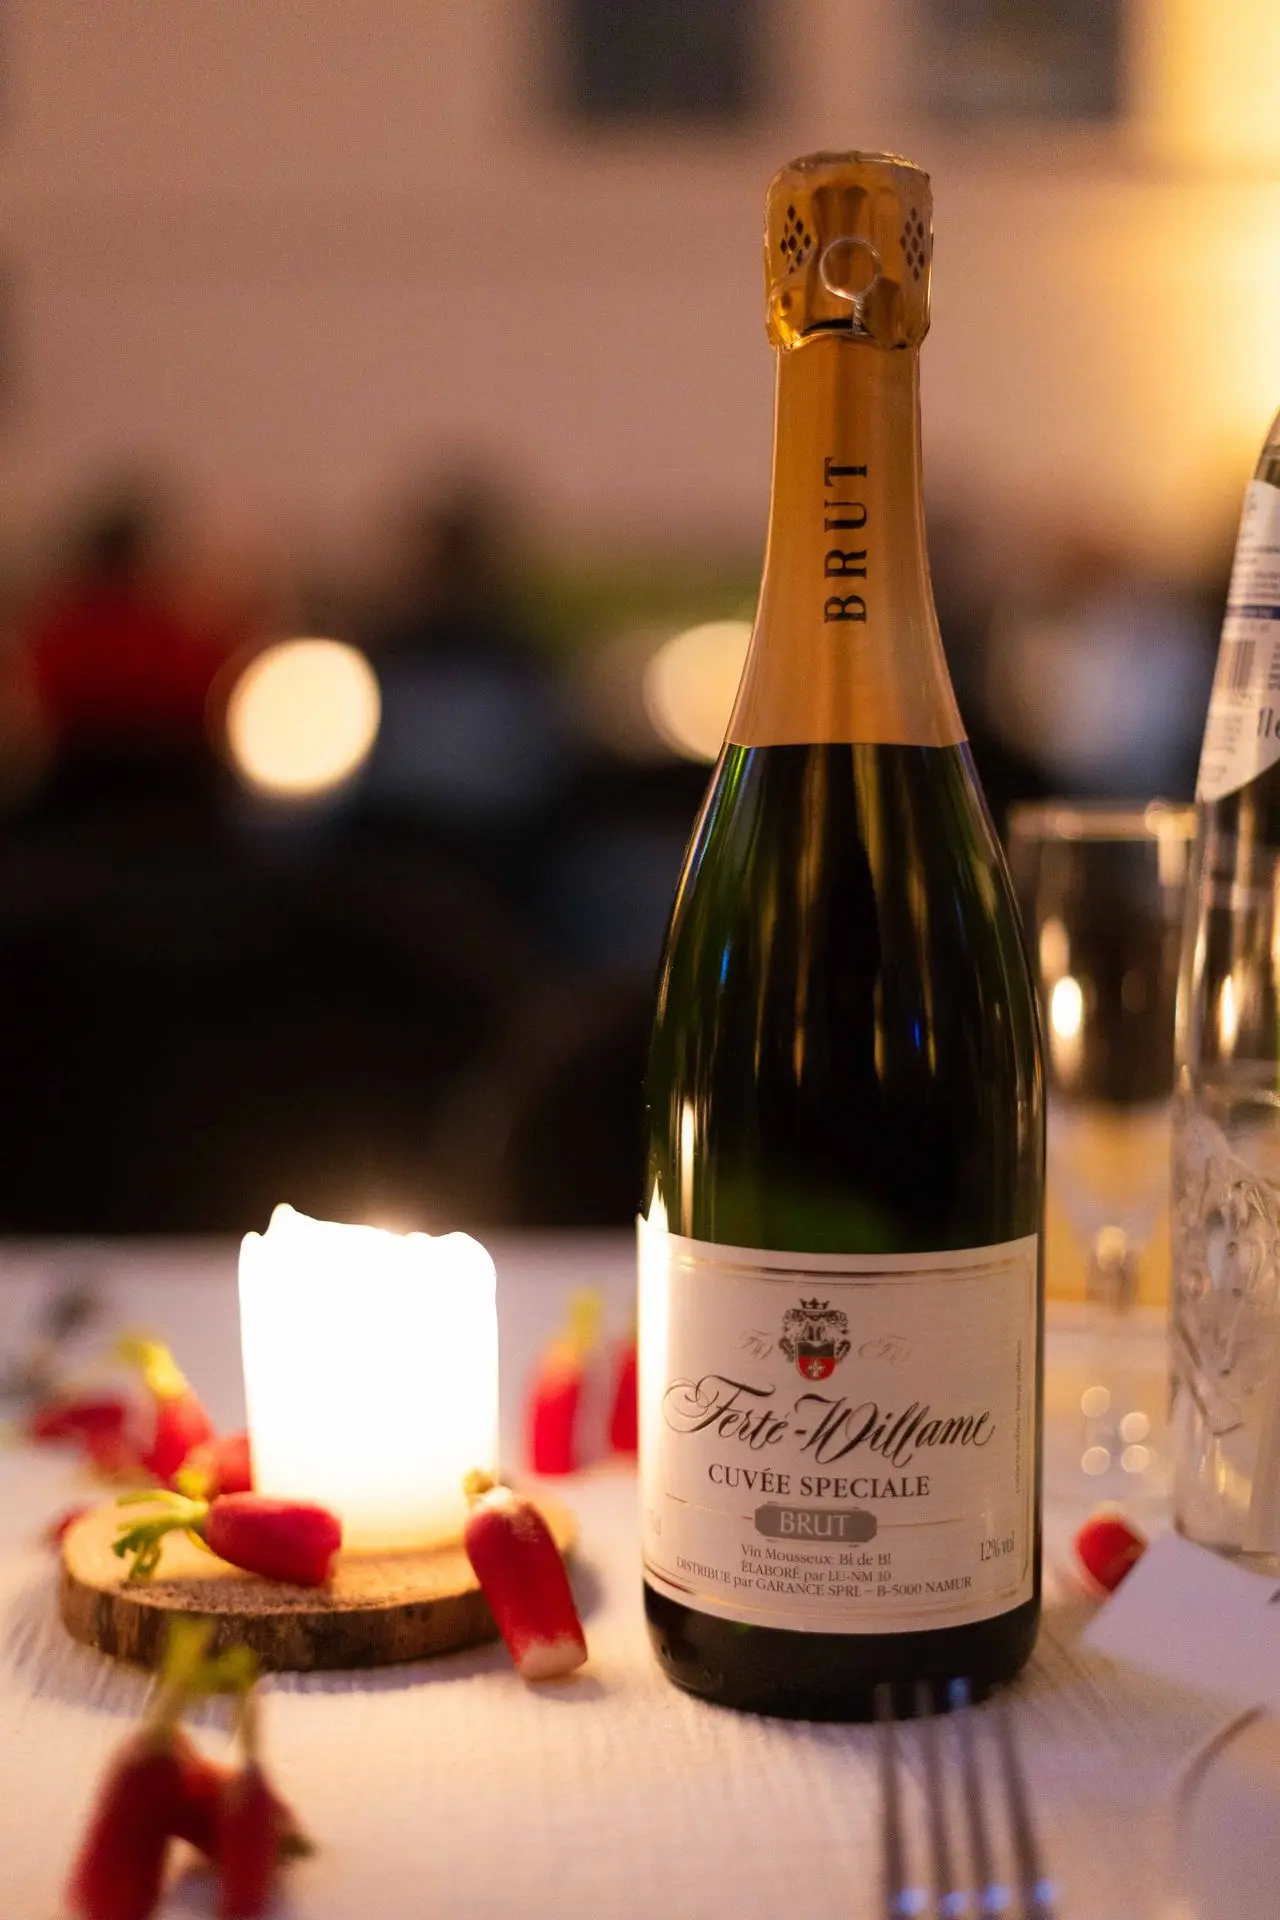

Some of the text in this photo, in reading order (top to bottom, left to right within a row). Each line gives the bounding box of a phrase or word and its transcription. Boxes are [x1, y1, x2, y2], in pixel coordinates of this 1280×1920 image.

[824, 456, 868, 624] BRUT
[708, 1463, 930, 1499] CUVÉE SPECIALE
[780, 1511, 850, 1537] BRUT
[741, 1543, 761, 1558] Vin
[857, 1552, 873, 1566] de
[733, 1576, 754, 1589] par
[756, 1578, 825, 1596] GARANCE
[828, 1584, 862, 1597] SPRL
[877, 1583, 922, 1598] B-5000
[925, 1576, 972, 1593] NAMUR
[804, 1571, 826, 1583] par
[878, 1571, 892, 1582] 10
